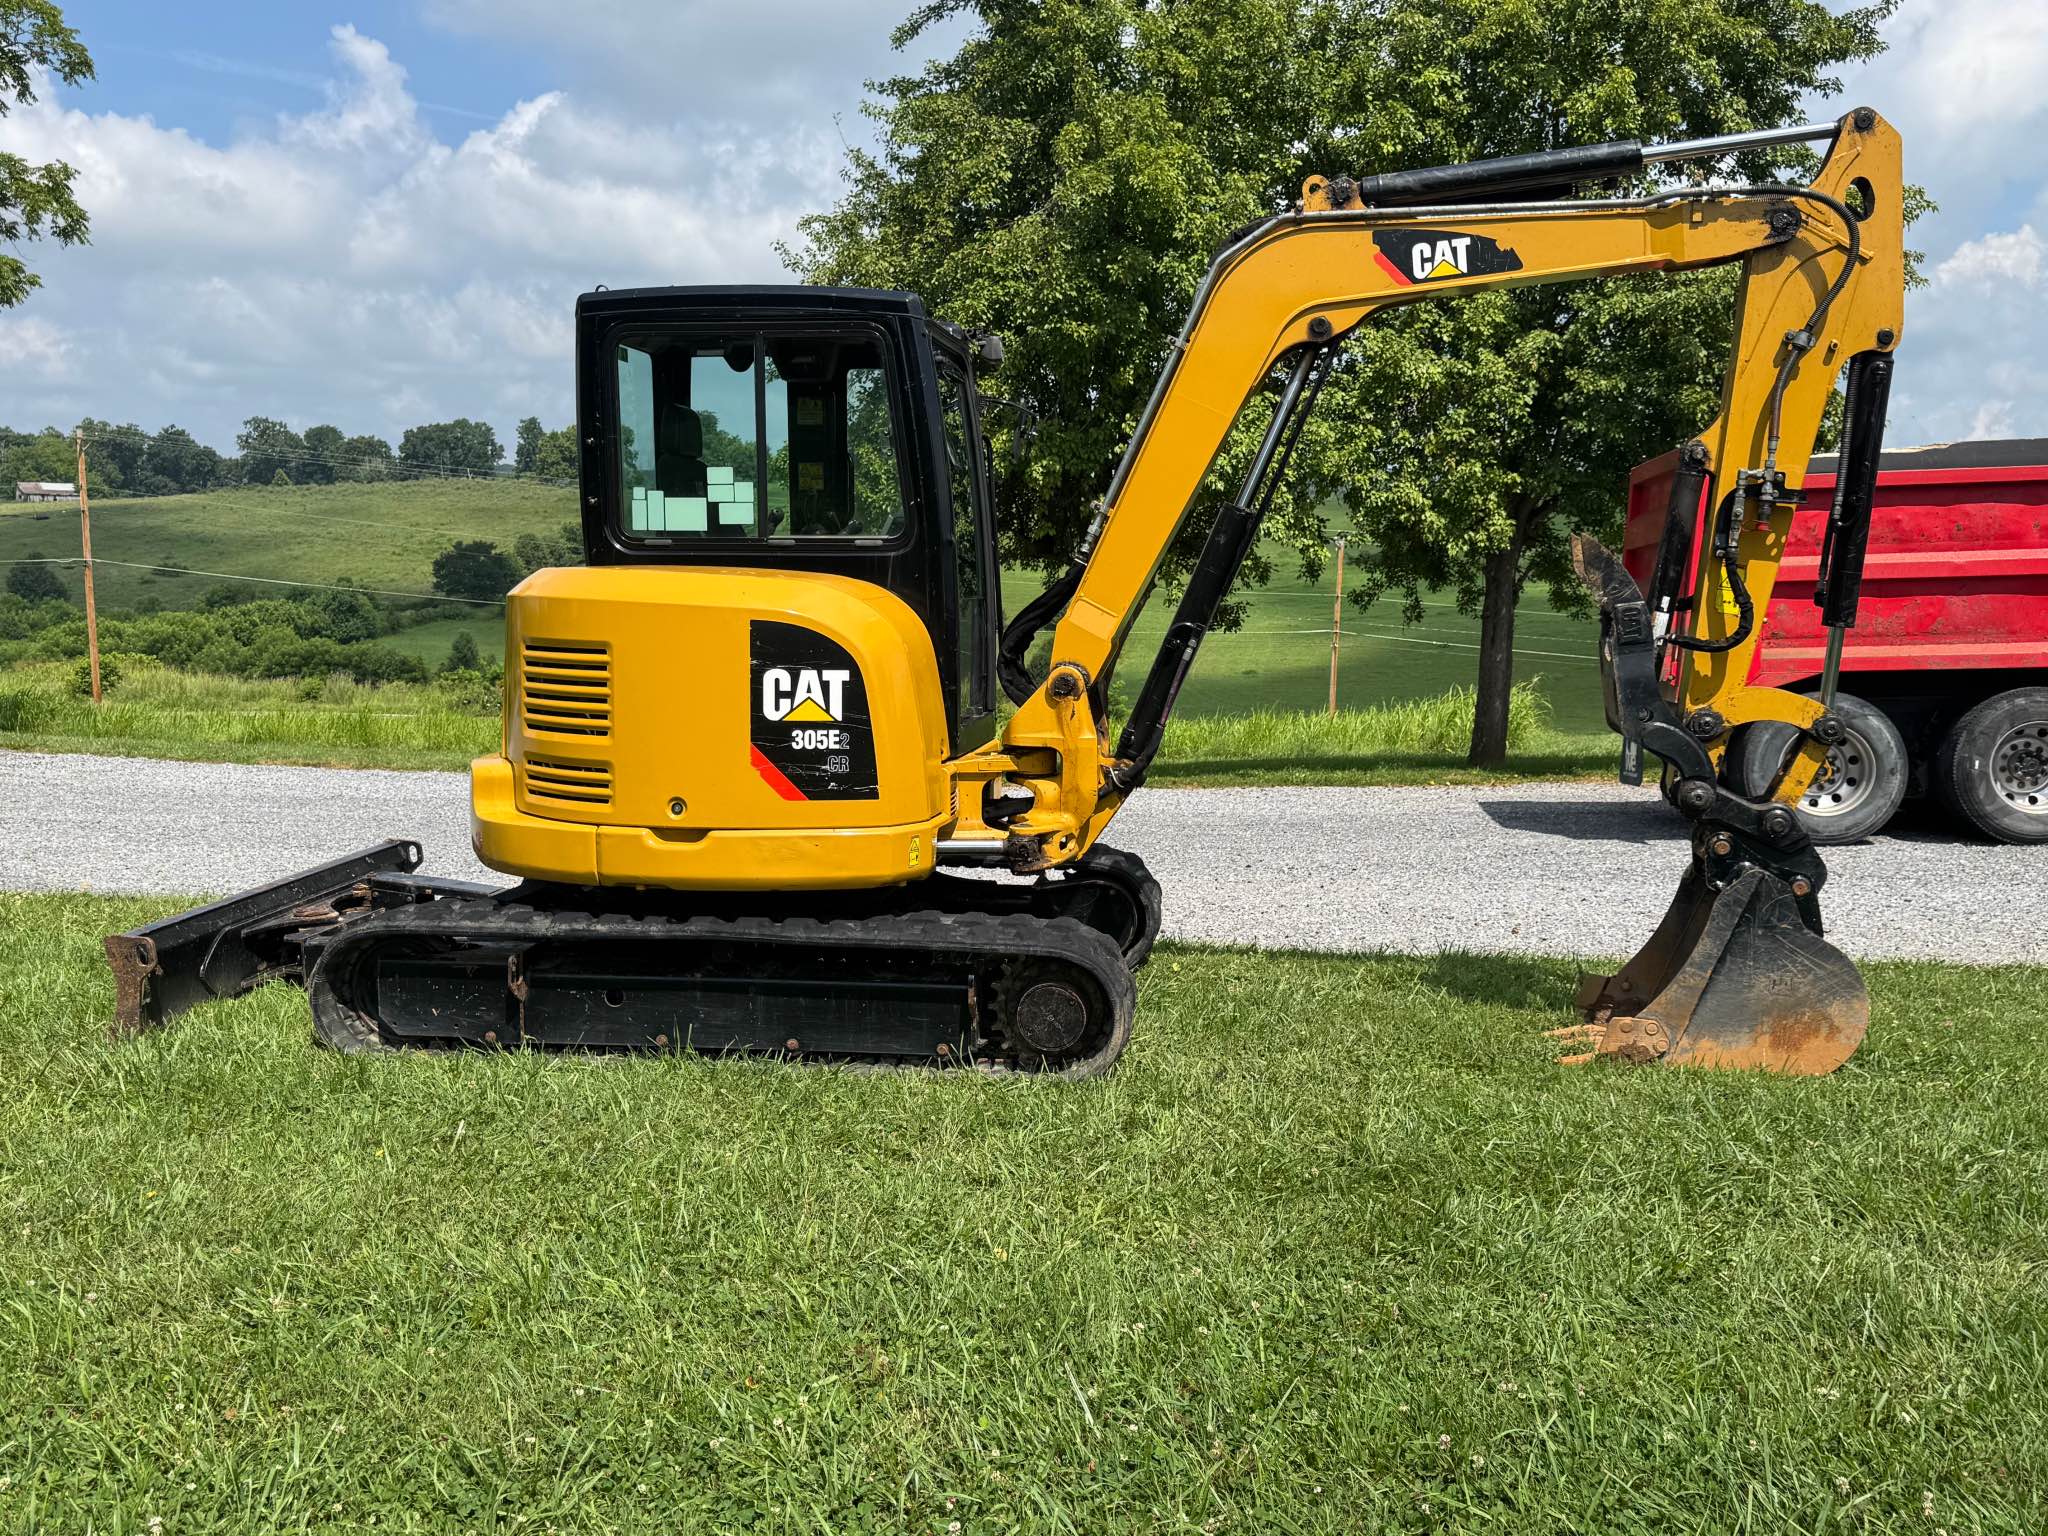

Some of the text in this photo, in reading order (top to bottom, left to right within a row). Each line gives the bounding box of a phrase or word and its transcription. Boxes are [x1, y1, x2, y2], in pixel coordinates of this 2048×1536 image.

[1411, 237, 1471, 279] CAT
[762, 668, 850, 721] CAT
[791, 729, 850, 750] 305E2
[827, 755, 850, 772] CR
